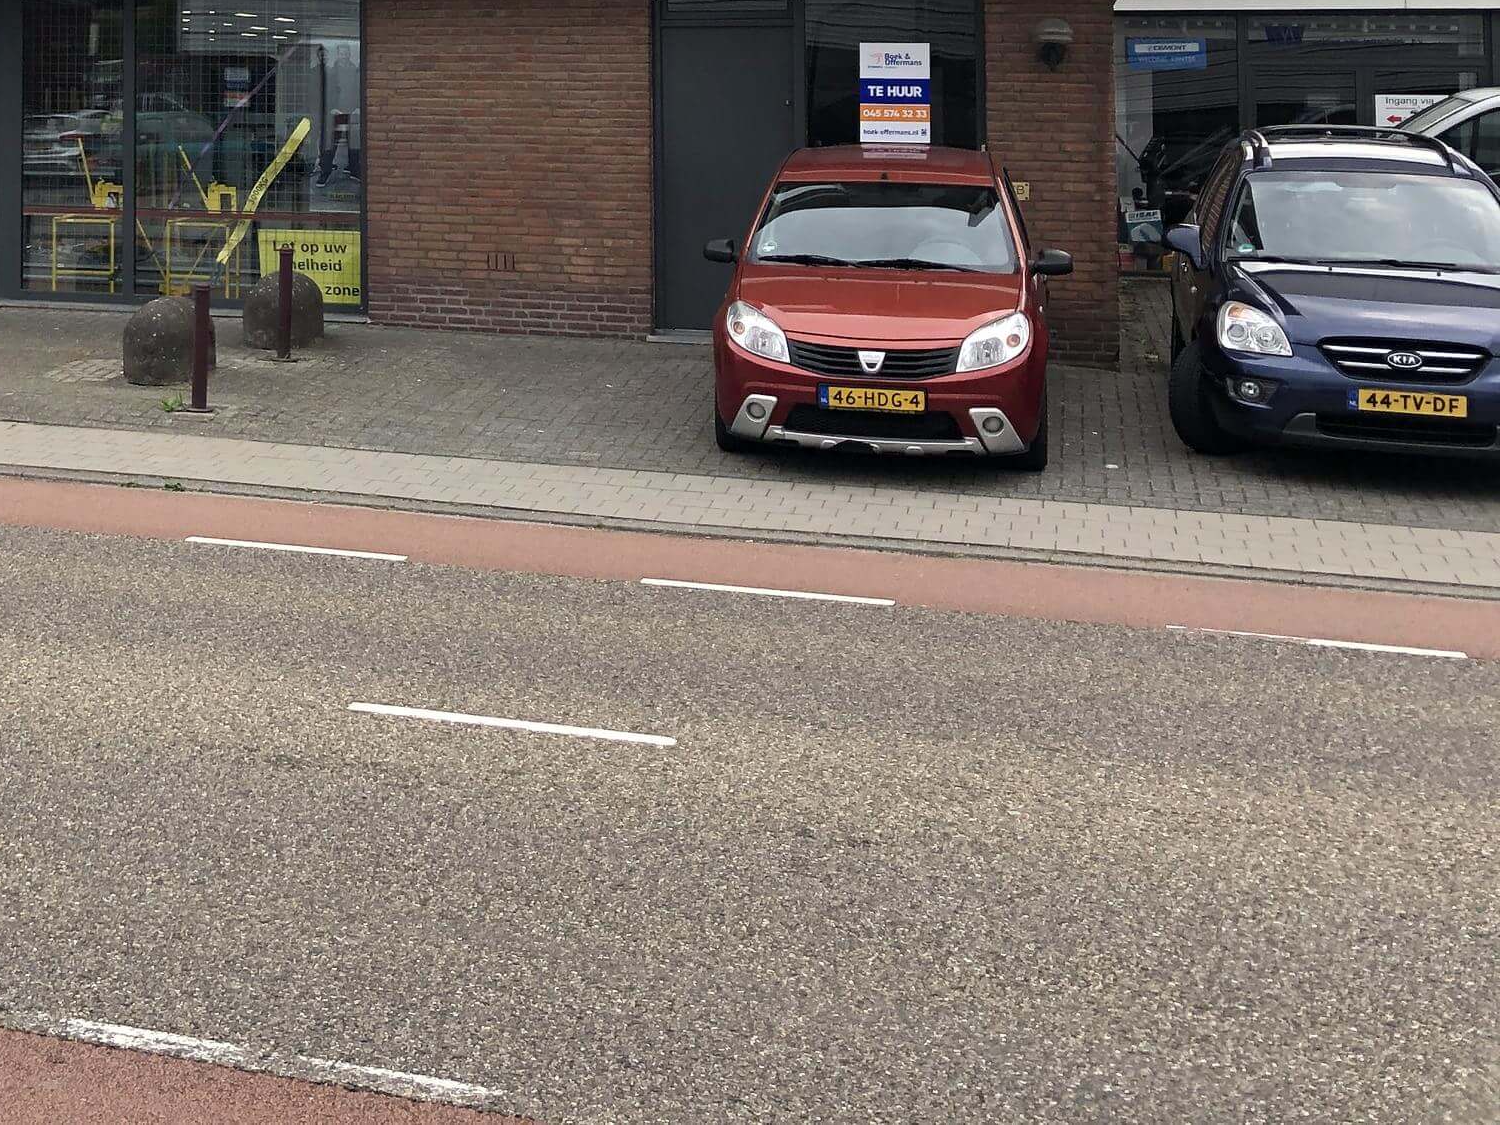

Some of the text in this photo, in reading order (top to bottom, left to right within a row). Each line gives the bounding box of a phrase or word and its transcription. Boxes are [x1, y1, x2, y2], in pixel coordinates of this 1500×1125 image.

[884, 52, 903, 60] Boek
[867, 85, 923, 97] TE HUUR
[1385, 97, 1418, 106] Ingang
[863, 108, 928, 118] 045 574 32 33
[300, 242, 319, 255] op
[324, 244, 347, 254] uw
[291, 258, 342, 272] nelheid
[325, 285, 360, 297] zone
[1393, 355, 1416, 365] KIA
[833, 390, 921, 408] 46-HDG-4
[1366, 393, 1460, 413] 44-TV-DF
